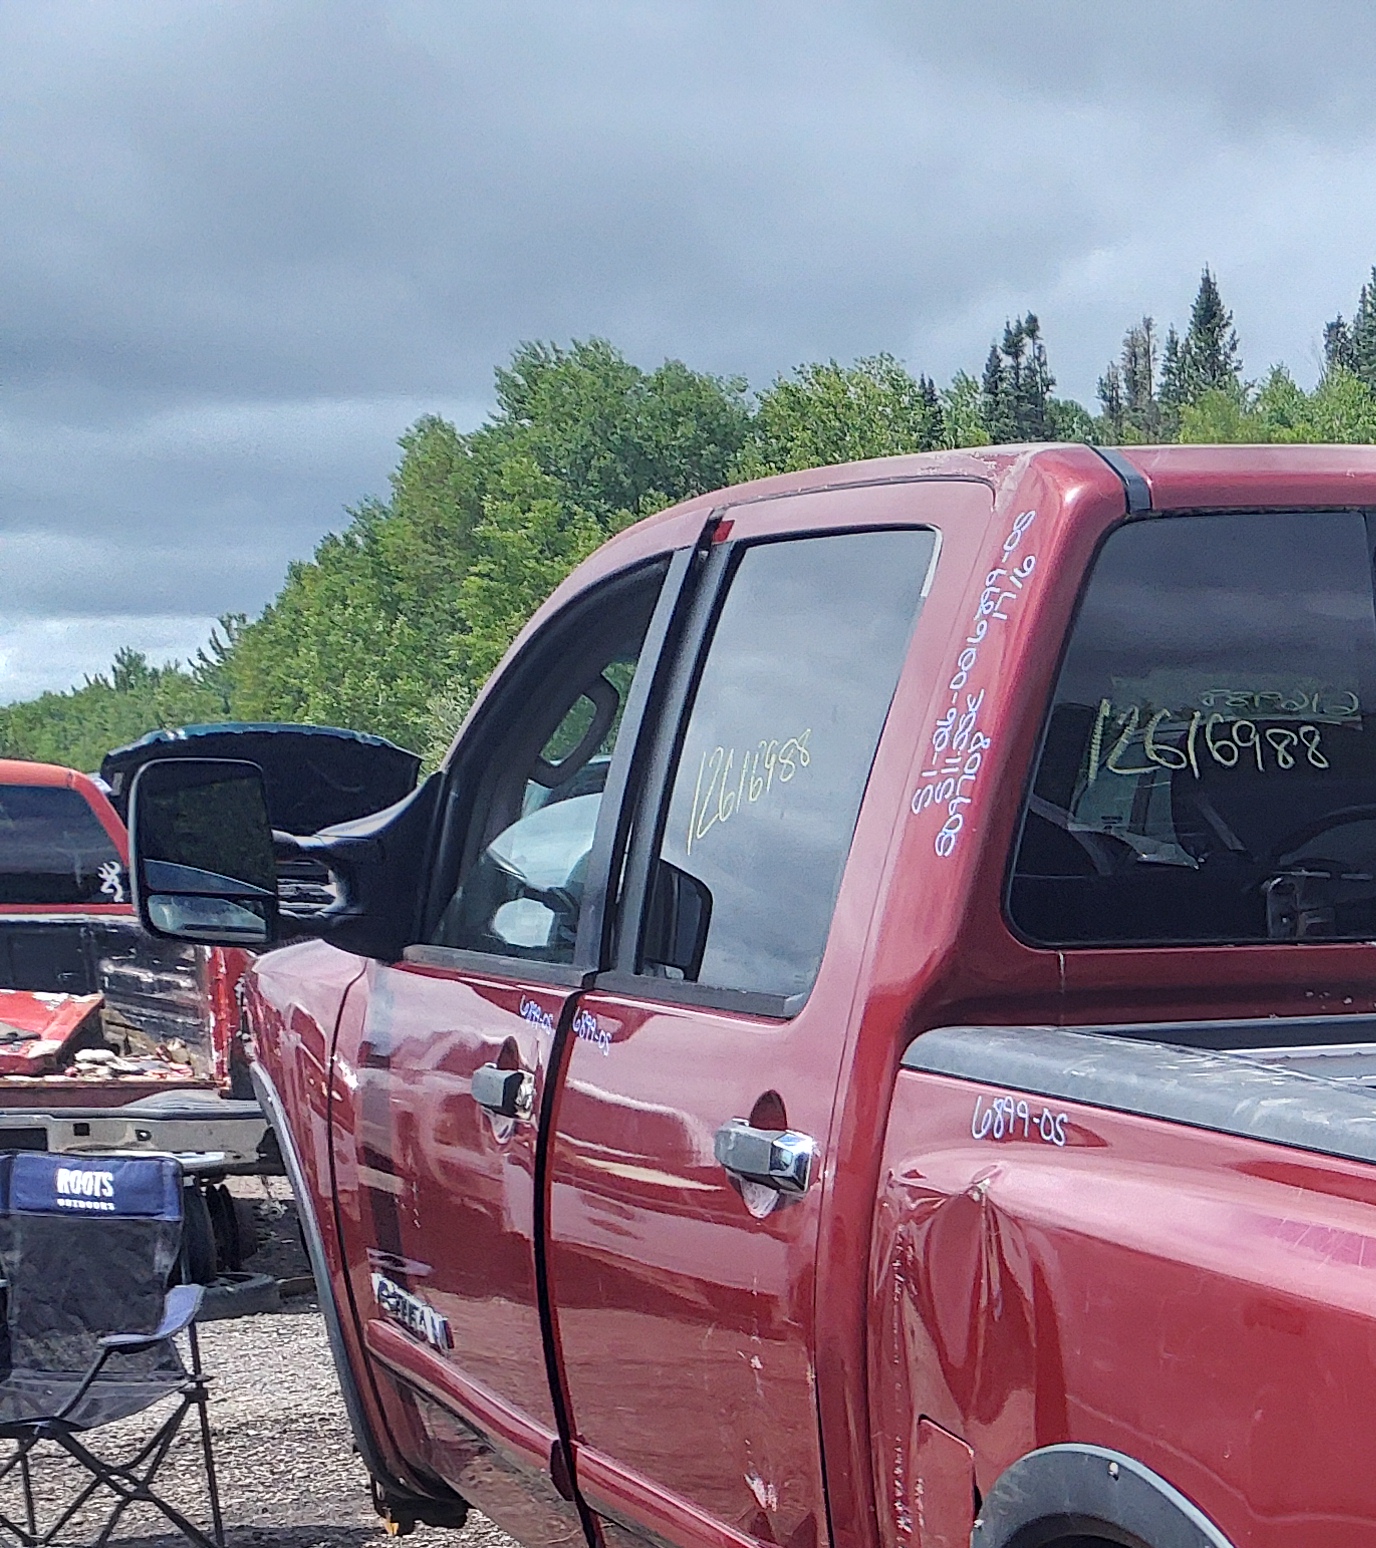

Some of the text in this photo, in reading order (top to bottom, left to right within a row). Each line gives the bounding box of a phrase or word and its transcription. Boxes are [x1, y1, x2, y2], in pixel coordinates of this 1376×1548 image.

[1089, 698, 1330, 780] 12616988
[57, 1168, 114, 1197] ROOTS
[57, 1199, 115, 1211] OUTDOORS
